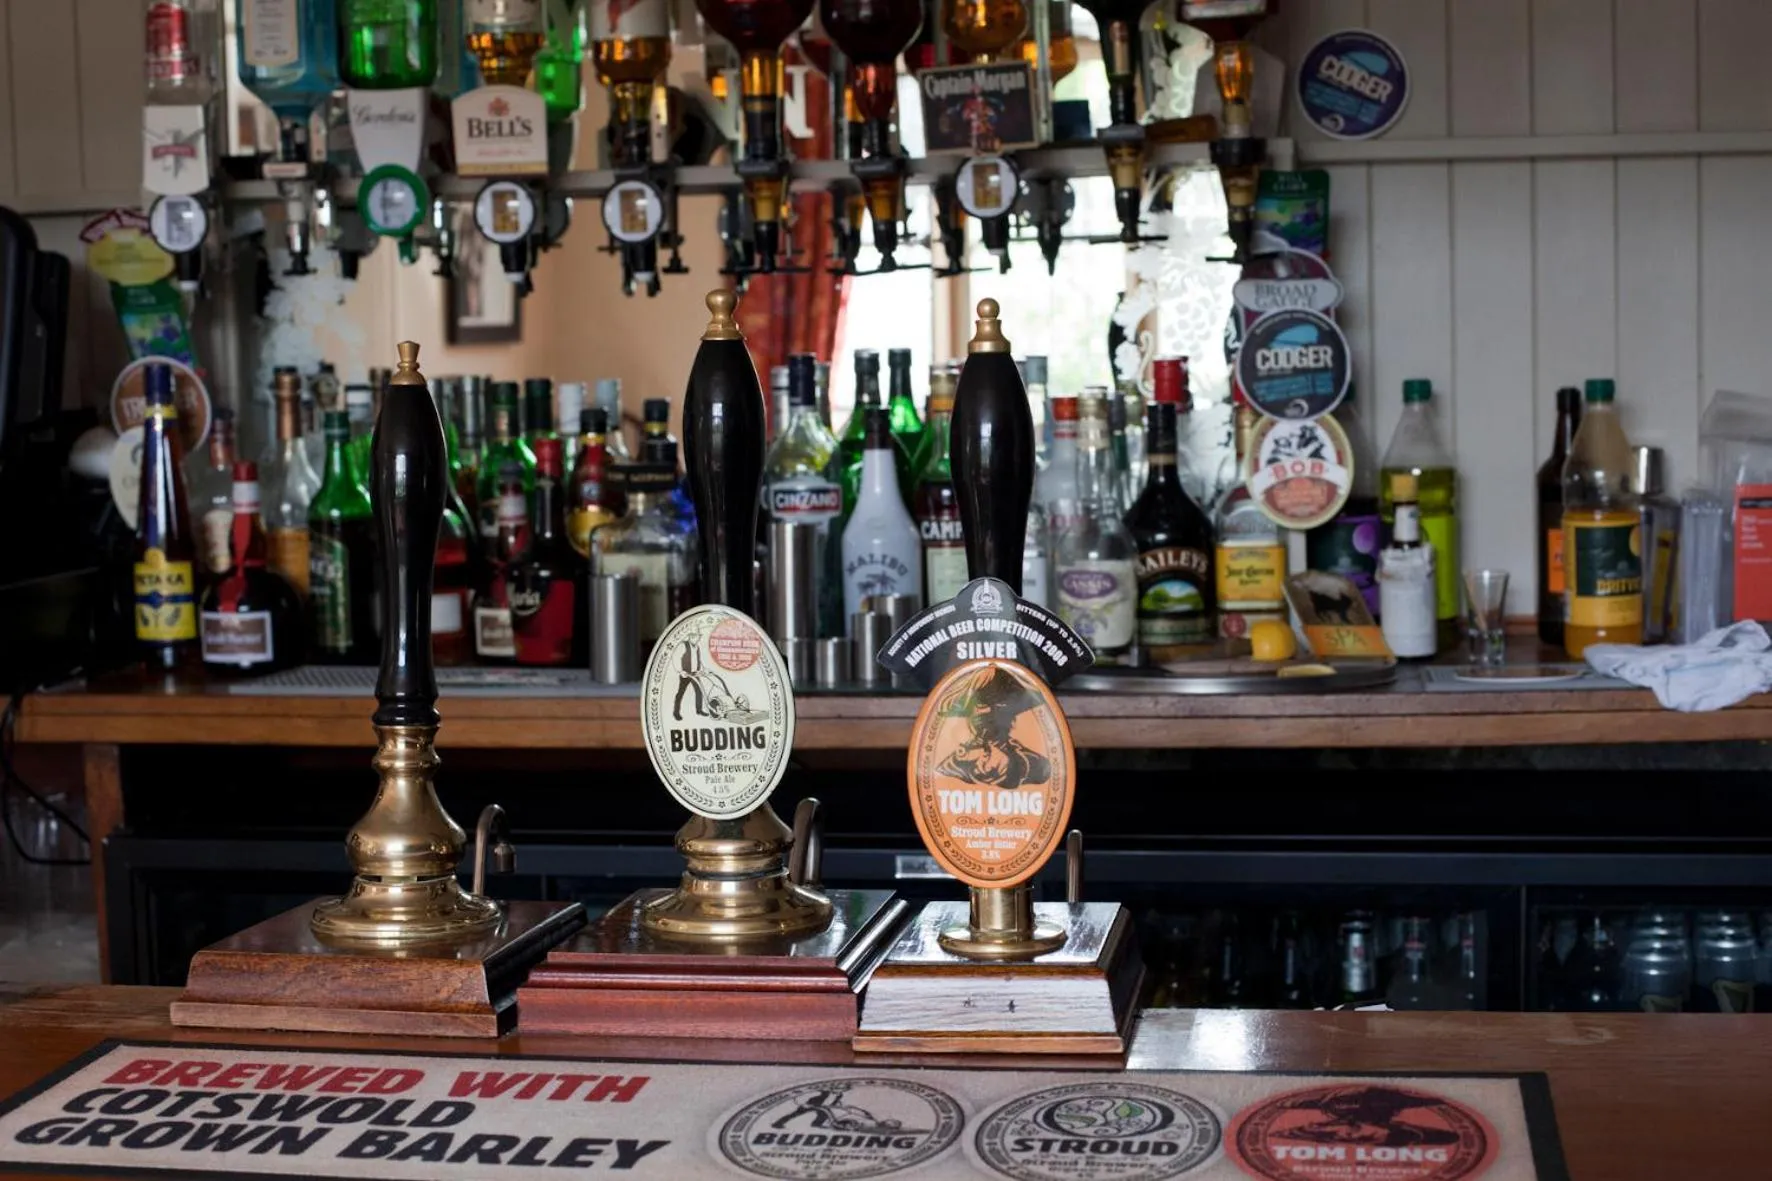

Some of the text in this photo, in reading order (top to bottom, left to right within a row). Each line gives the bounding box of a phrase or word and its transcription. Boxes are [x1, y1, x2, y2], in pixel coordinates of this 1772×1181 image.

[467, 115, 533, 139] BELL'S
[1254, 283, 1318, 298] BROAD
[1272, 460, 1325, 480] BOB
[775, 491, 838, 509] CINZANO
[846, 552, 909, 577] MALIBU
[1016, 603, 1047, 622] BITTERS
[1045, 618, 1060, 630] (UP
[1058, 627, 1069, 639] TO
[904, 618, 1069, 668] NATIONAL BEER COMPETITION 2008
[956, 641, 1018, 660] SILVER
[670, 726, 766, 752] BUDDING
[682, 763, 759, 775] Stroud Brewery
[704, 774, 736, 785] Pale Ale
[937, 790, 1044, 816] TOM LONG
[951, 825, 1032, 841] Stroud Brewery
[101, 1059, 652, 1103] BREWED WITH
[62, 1087, 477, 1128] COTSWOLD
[14, 1116, 673, 1170] GROWN BARLEY
[751, 1132, 918, 1150] BUDDING
[1010, 1138, 1179, 1157] STROUD
[759, 1151, 890, 1162] Stroud Brewery
[1272, 1144, 1448, 1163] TOM LONG
[1021, 1158, 1158, 1170] Stroud Brewery
[1293, 1165, 1431, 1177] Stroud Brewery
